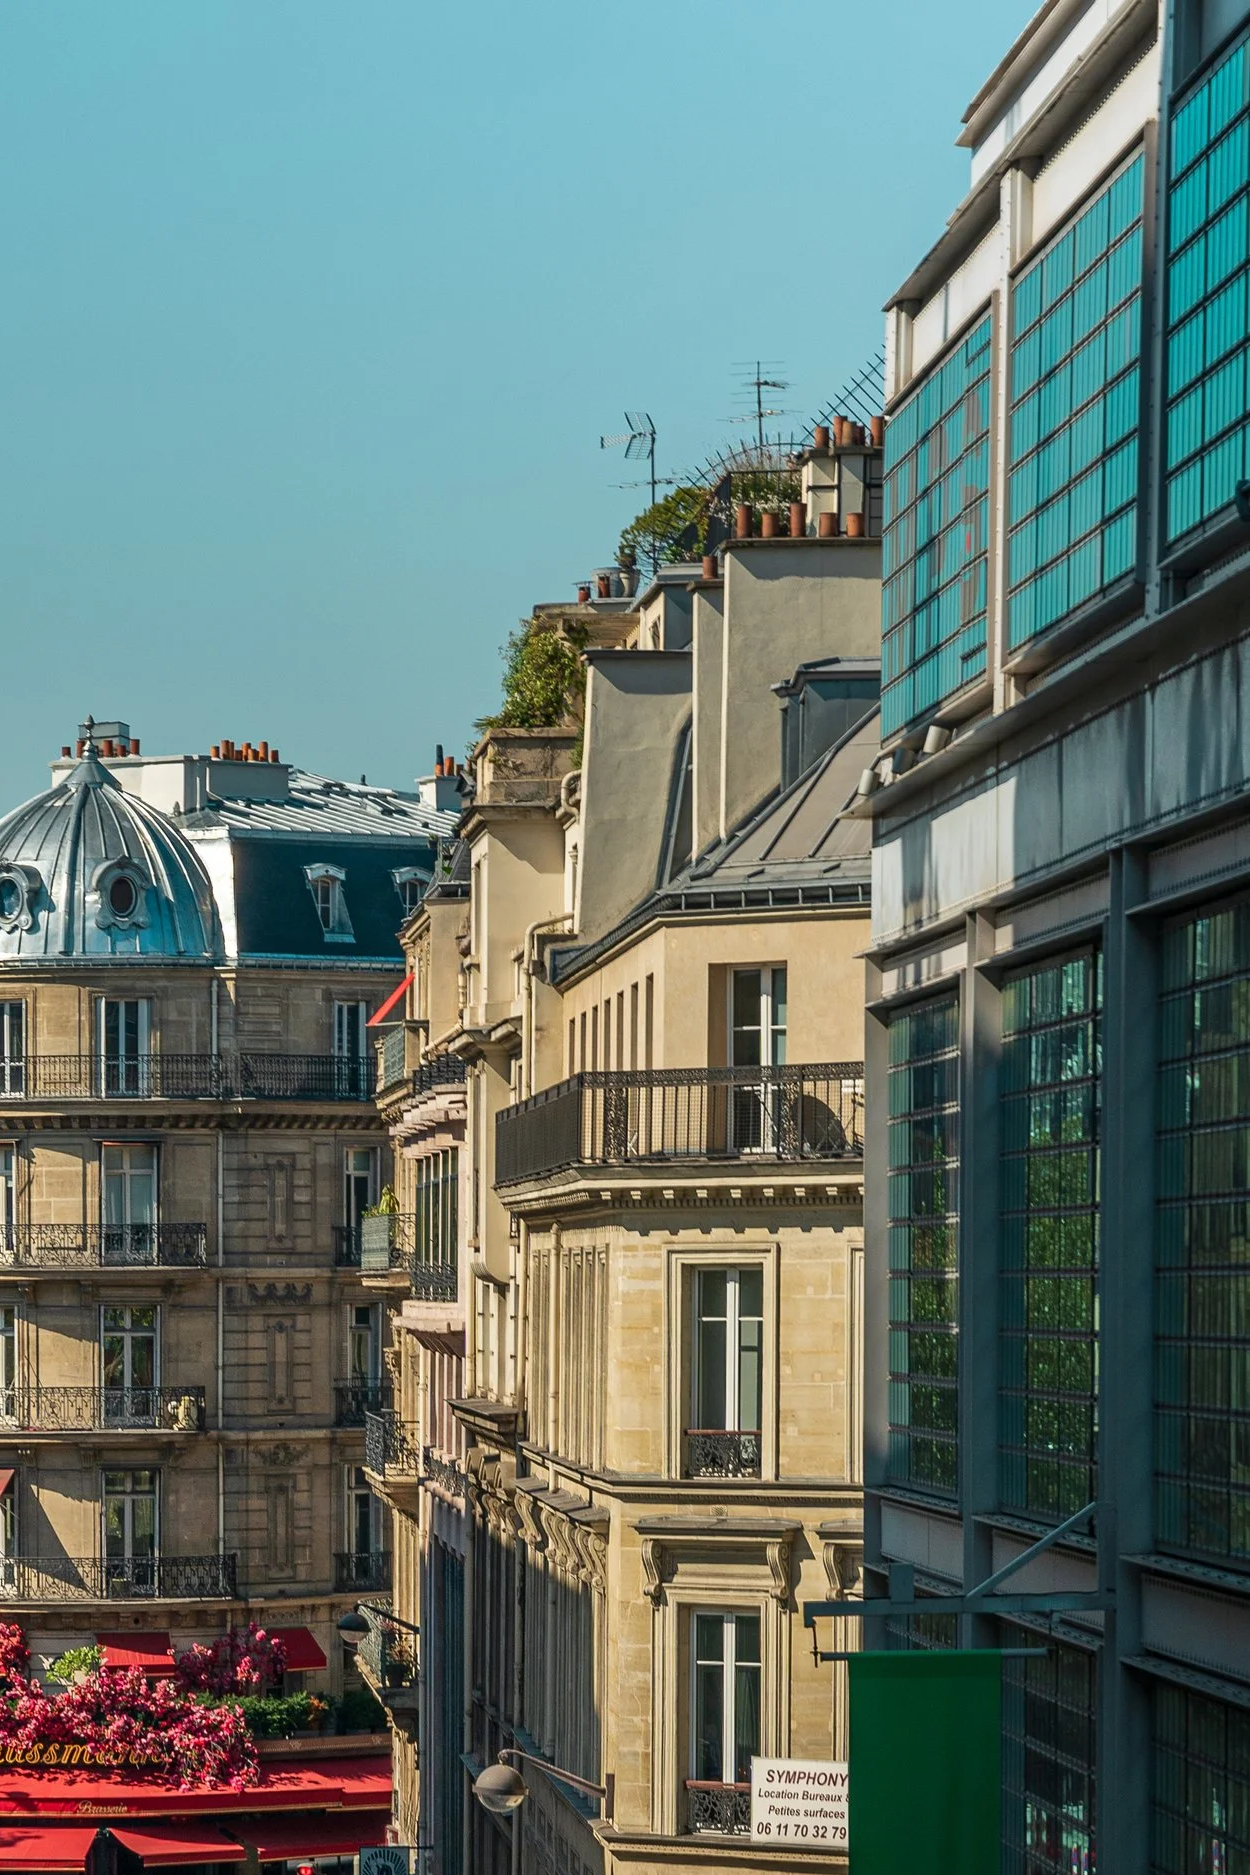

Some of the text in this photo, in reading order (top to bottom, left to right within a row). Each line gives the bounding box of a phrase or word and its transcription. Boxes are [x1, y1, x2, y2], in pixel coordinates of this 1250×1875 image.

[766, 1769, 849, 1787] SYMPHONY
[758, 1787, 799, 1800] Location
[802, 1790, 842, 1803] Bureaux
[76, 1800, 128, 1814] Brasserie
[768, 1804, 845, 1819] Petites surfaces
[757, 1821, 847, 1840] 06 11 70 32 79
